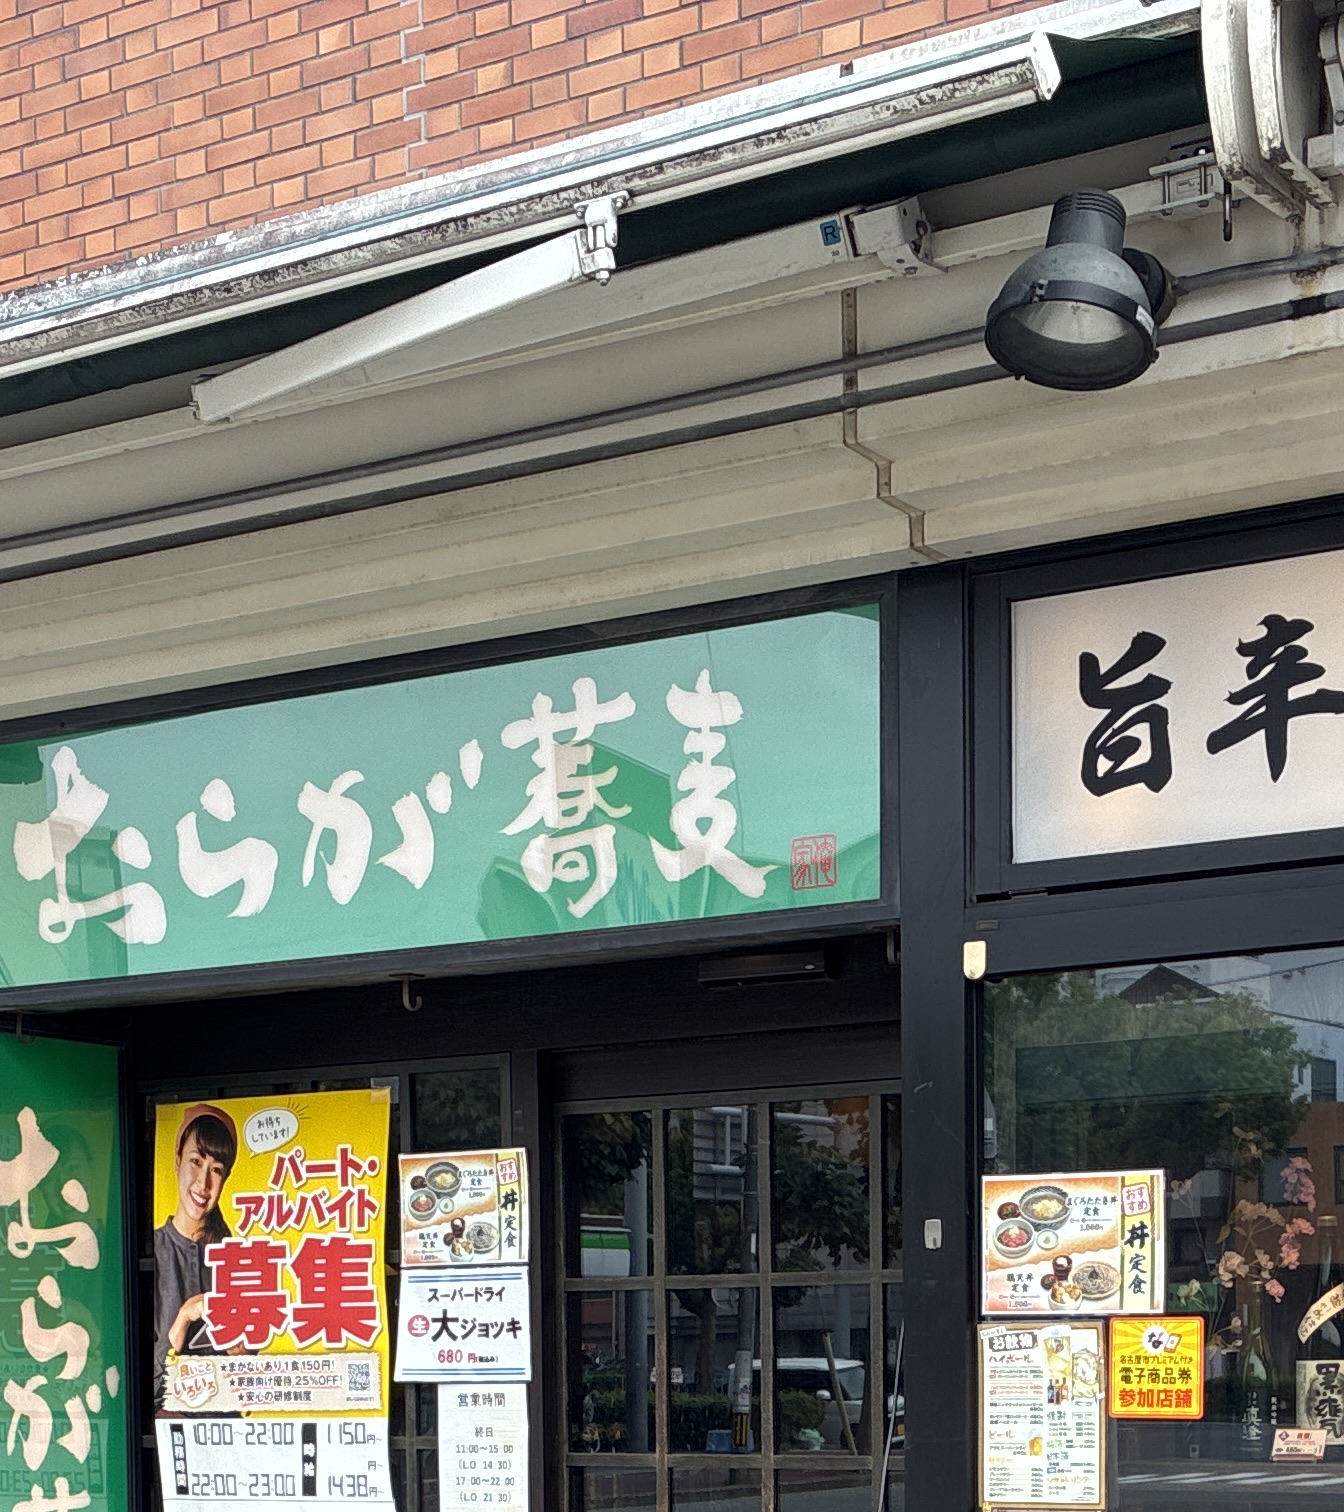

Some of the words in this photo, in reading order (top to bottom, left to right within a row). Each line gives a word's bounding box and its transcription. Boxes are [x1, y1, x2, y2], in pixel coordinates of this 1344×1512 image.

[12, 667, 781, 946] おらが蕎麦
[233, 1188, 380, 1233] アルバイト
[206, 1235, 381, 1350] 募集
[427, 1286, 506, 1303] スーパードライ
[437, 1349, 463, 1364] 680
[1119, 1366, 1193, 1385] 電子商品券
[457, 1392, 506, 1408] 営業時間
[1118, 1387, 1193, 1409] 参加店舗
